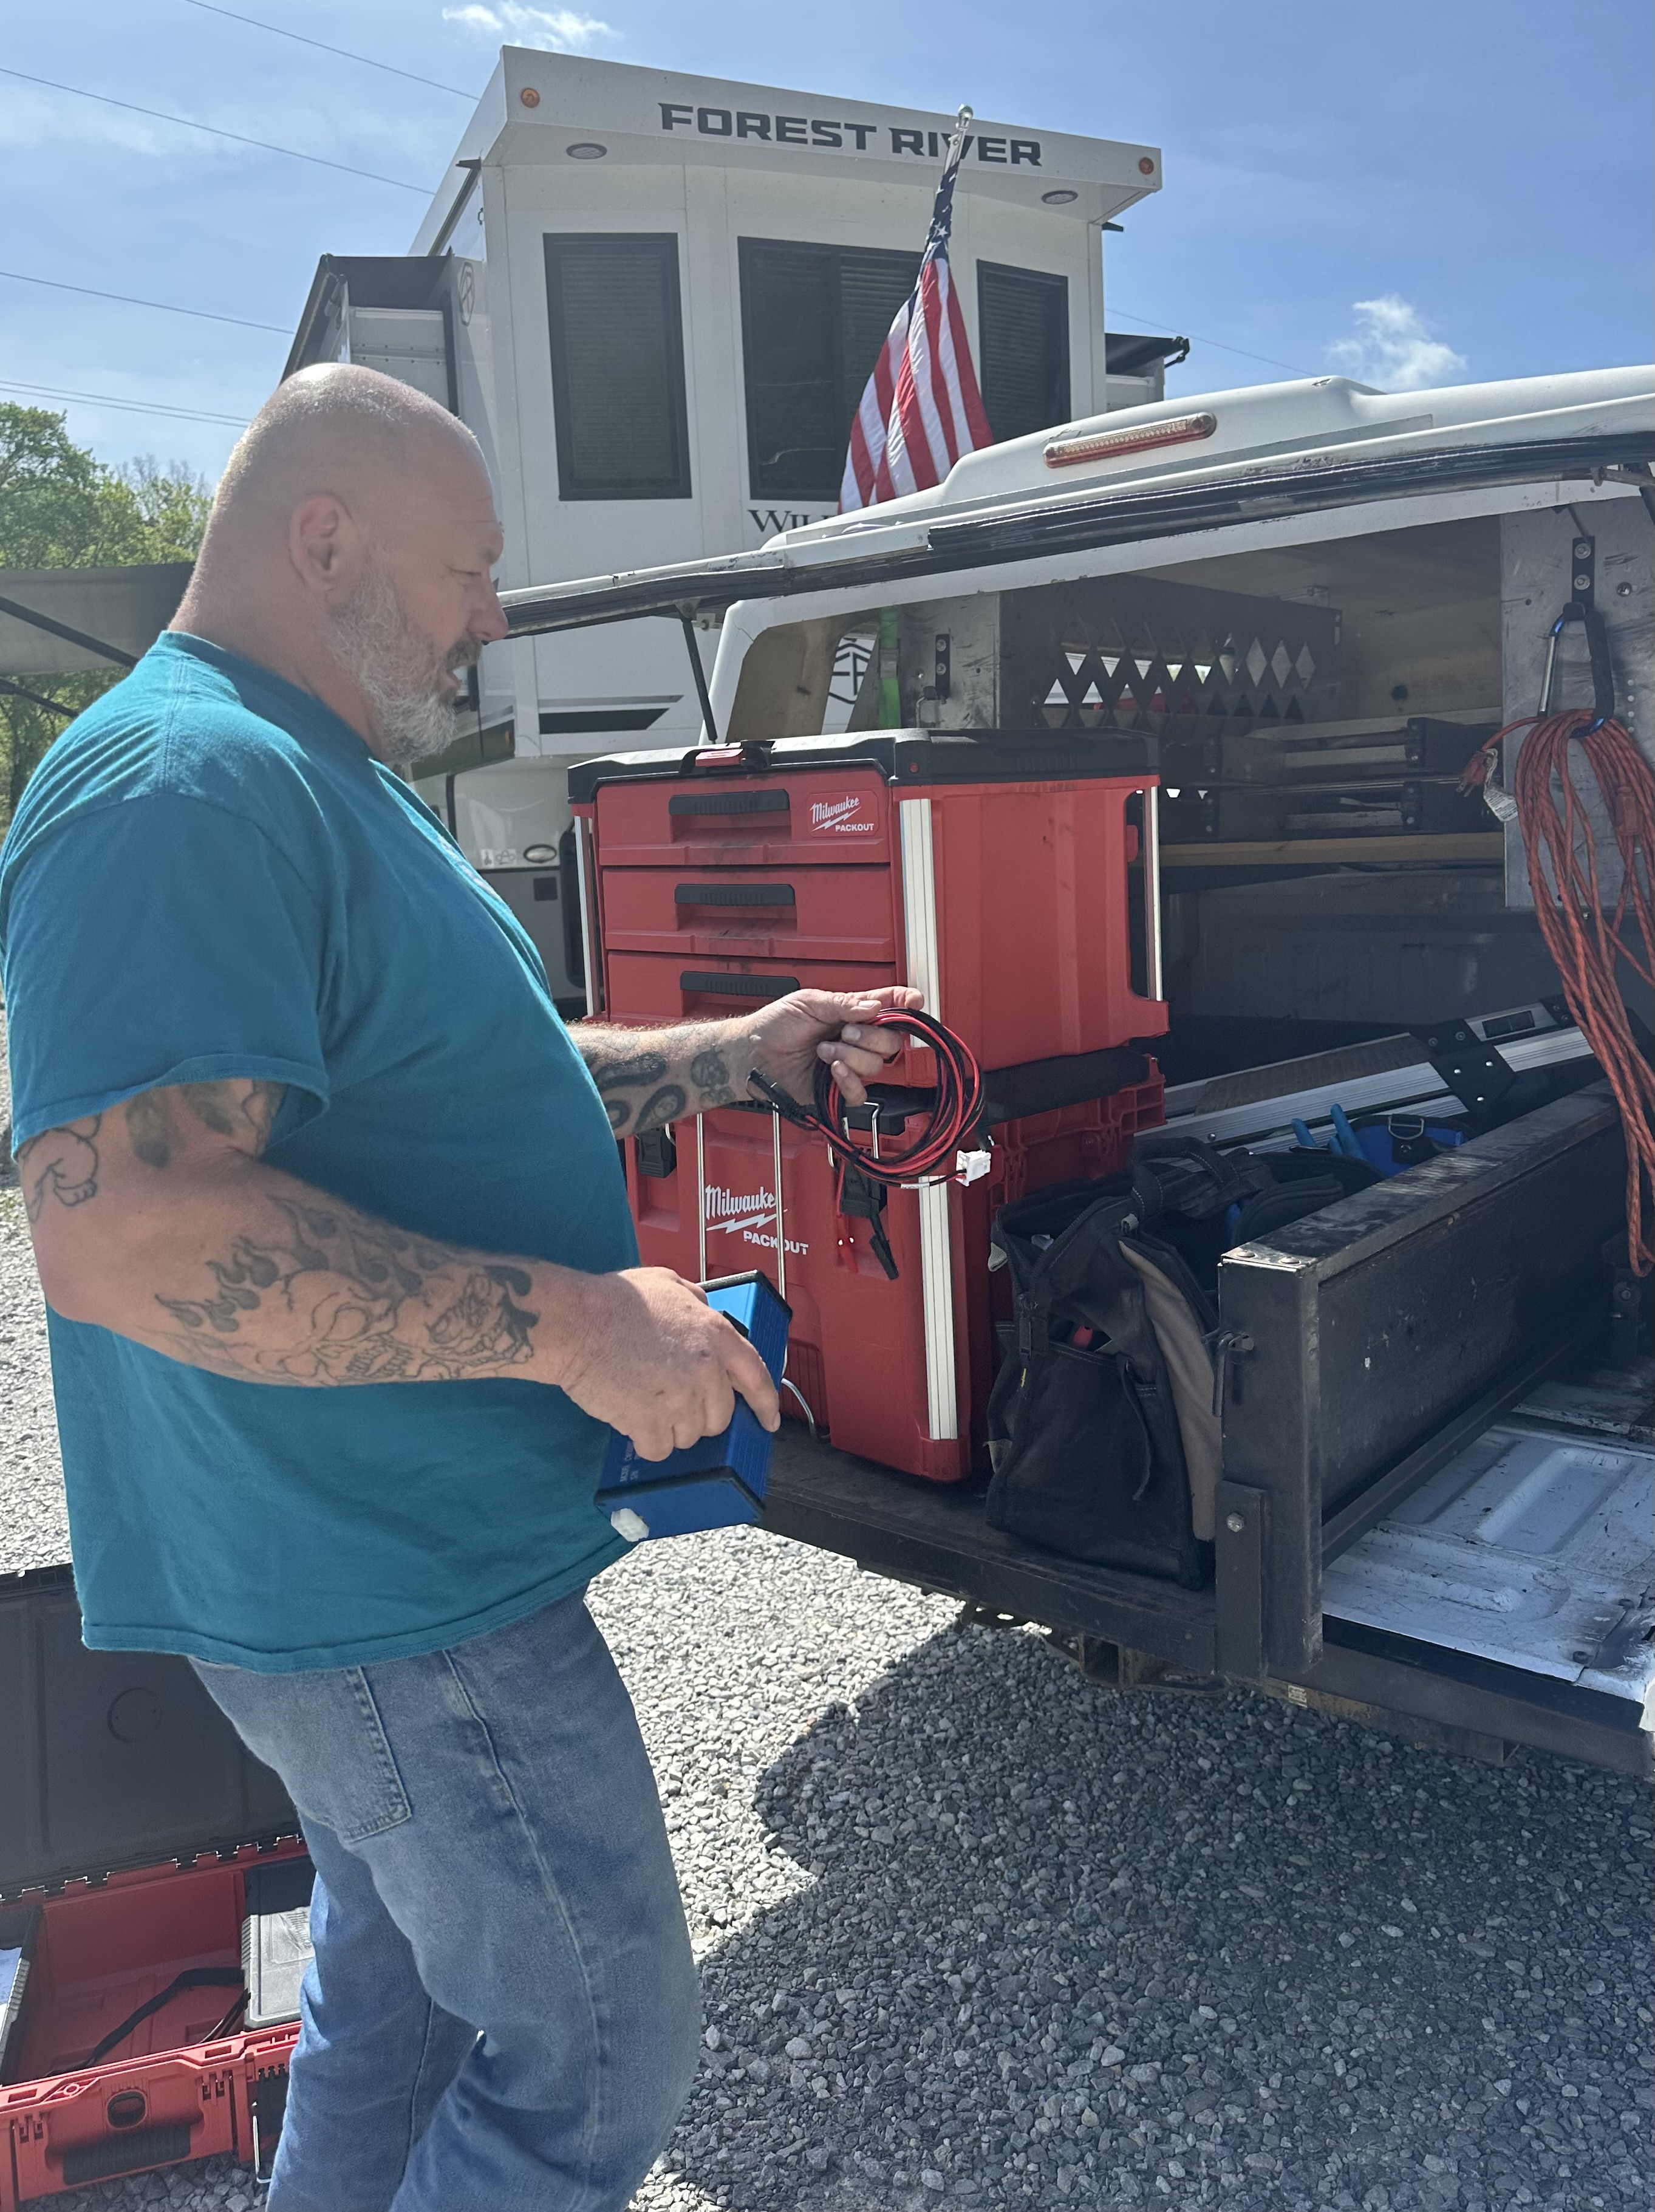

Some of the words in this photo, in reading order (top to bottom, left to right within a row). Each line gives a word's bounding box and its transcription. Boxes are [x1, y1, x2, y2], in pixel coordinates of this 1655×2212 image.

[658, 103, 877, 150] FOREST
[889, 128, 1042, 166] RIVER
[810, 796, 860, 824] Milwaukee
[835, 824, 875, 832] PACKOUT
[705, 1184, 777, 1220] Milwauke
